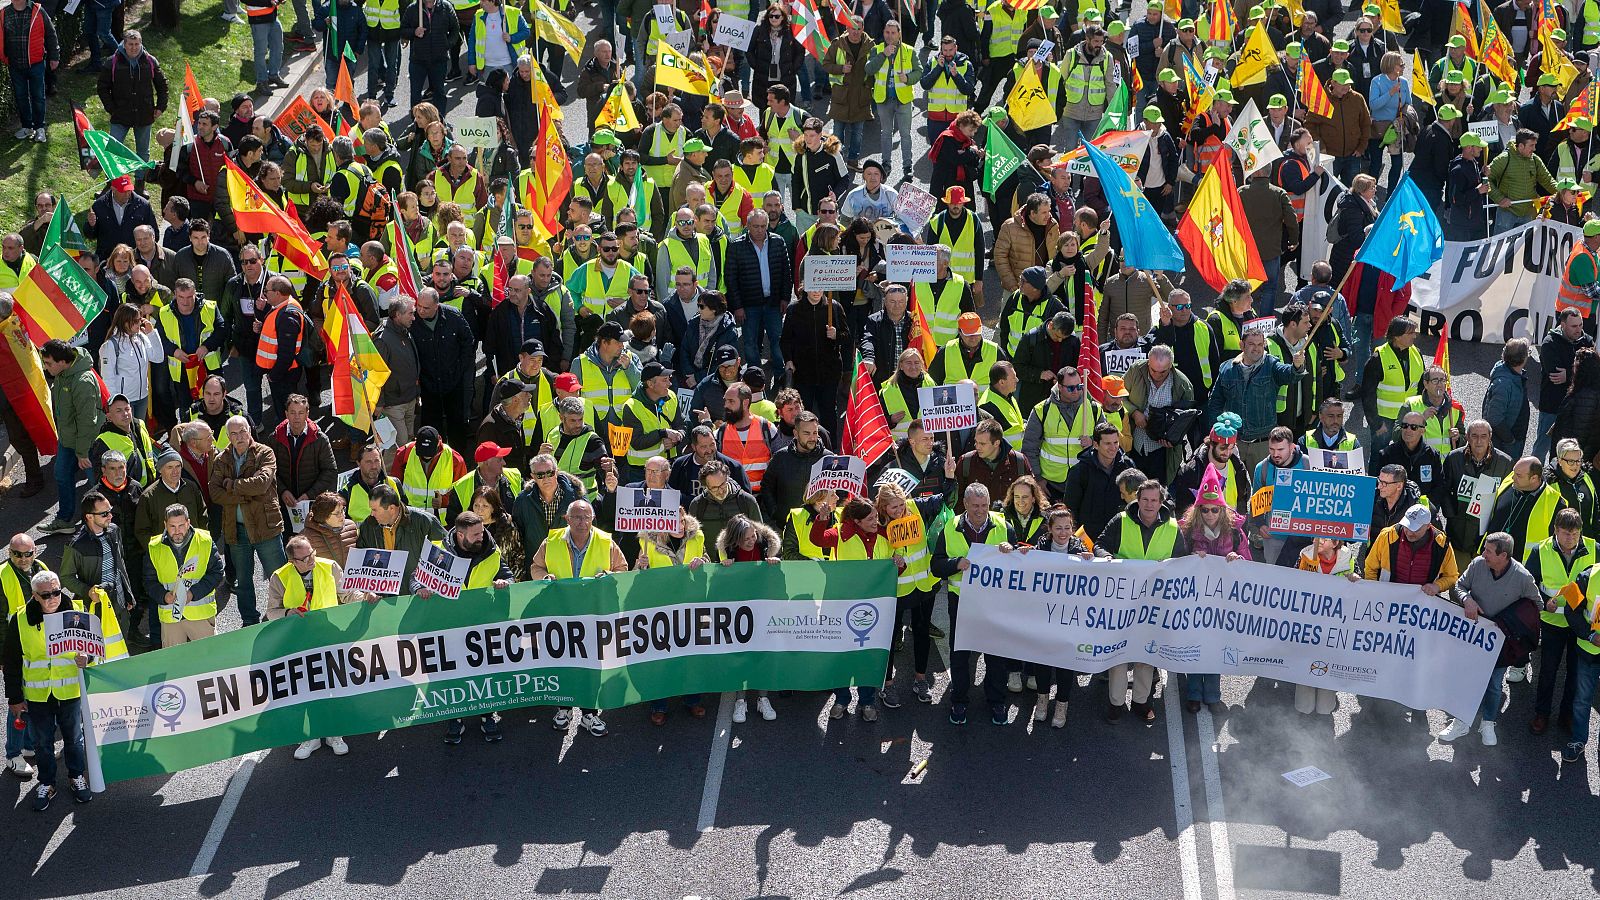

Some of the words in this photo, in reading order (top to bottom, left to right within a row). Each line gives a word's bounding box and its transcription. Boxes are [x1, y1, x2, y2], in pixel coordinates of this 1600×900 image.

[719, 25, 745, 39] UAGA
[460, 128, 491, 137] UAGA
[1071, 163, 1091, 173] UPA
[1293, 480, 1356, 499] SALVEMOS
[1291, 496, 1301, 512] A
[1305, 497, 1353, 518] PESCA
[617, 516, 677, 531] ¡DIMISIÓN!
[1292, 522, 1312, 532] SOS
[1314, 525, 1347, 535] PESCA
[343, 577, 399, 593] ¡DIMISIÓN!
[968, 563, 1003, 588] POR
[1008, 569, 1027, 592] EL
[1032, 571, 1100, 597] FUTURO
[1104, 576, 1125, 600] DE
[1130, 578, 1148, 600] LA
[1150, 575, 1199, 602] PESCA,
[1204, 575, 1223, 599] LA
[1228, 580, 1348, 624] ACUICULTURA,
[1352, 600, 1384, 623] LAS
[1387, 602, 1498, 652] PESCADERÍAS
[1046, 602, 1057, 623] Y
[1060, 604, 1079, 627] LA
[1085, 606, 1136, 631] SALUD
[1137, 605, 1161, 625] DE
[1161, 608, 1190, 631] LOS
[1193, 606, 1323, 645] CONSUMIDORES
[1325, 627, 1349, 650] EN
[1352, 629, 1415, 660] ESPAÑA
[48, 639, 105, 658] ¡DIMISIÓN!
[1077, 640, 1128, 657] cepesca
[196, 673, 242, 720] EN
[249, 643, 390, 706] DEFENSA
[396, 635, 457, 678] DEL
[464, 620, 588, 668] SECTOR
[596, 605, 754, 661] PESQUERO
[1242, 656, 1284, 665] APROMAR
[1331, 663, 1378, 675] FEDEPESCA
[397, 711, 435, 723] Asociación
[435, 706, 468, 717] Andaluza
[478, 700, 507, 710] Mujeres
[520, 695, 542, 703] Sector
[543, 694, 575, 703] Pesquero
